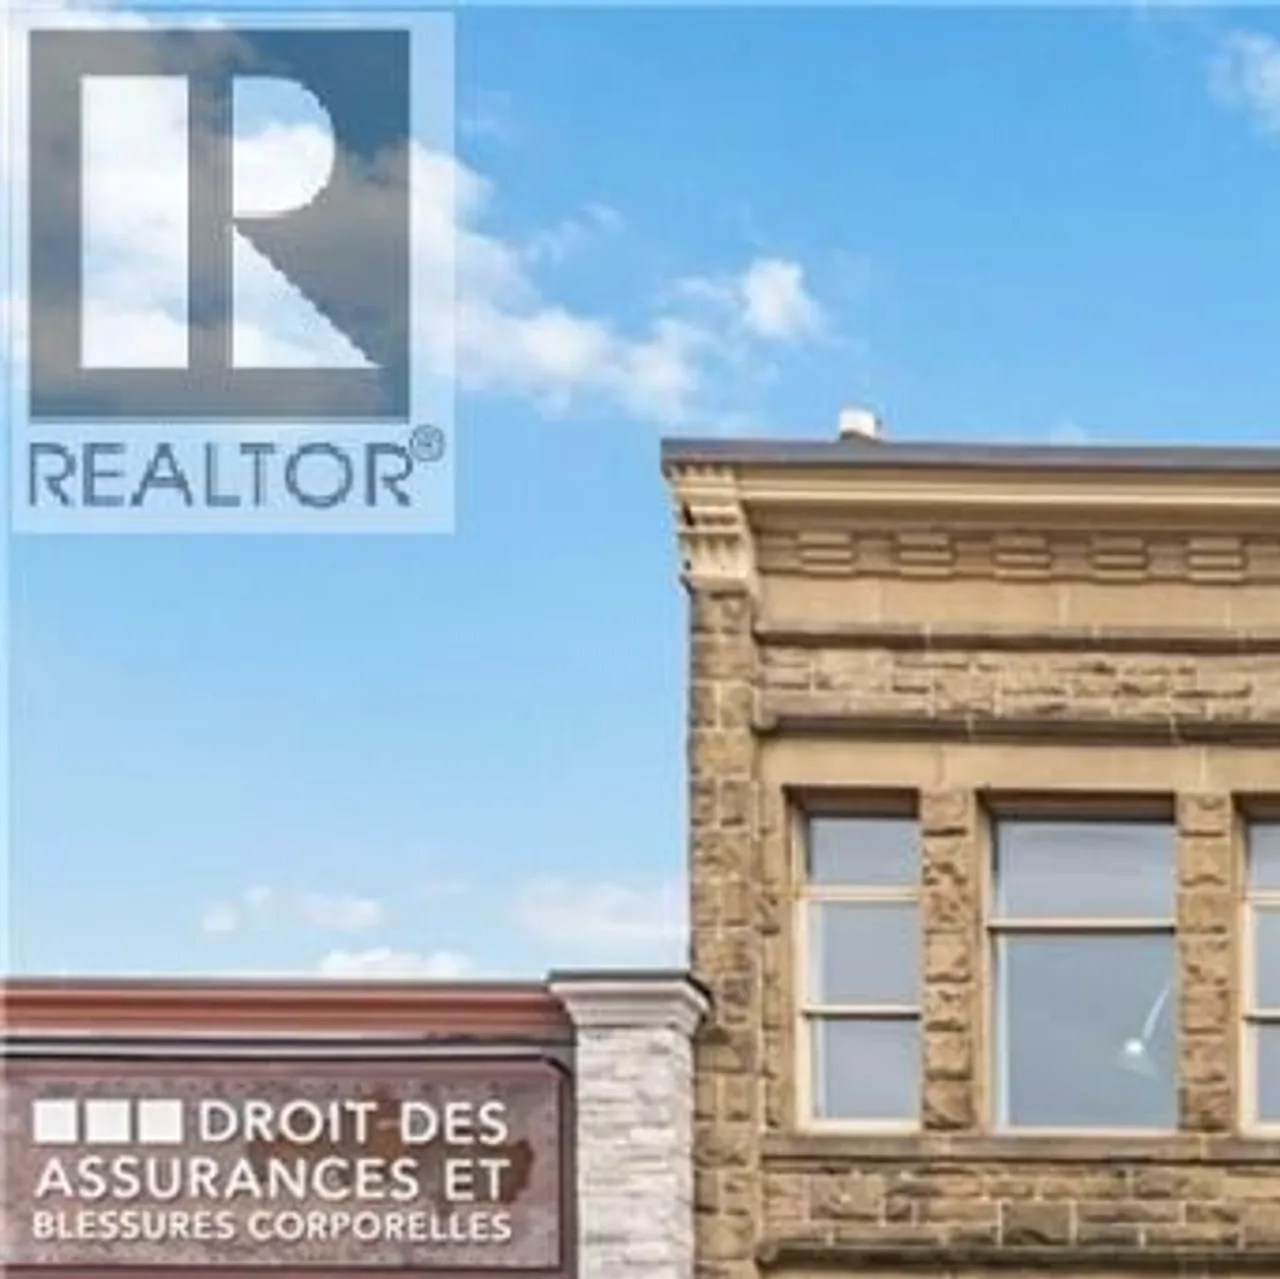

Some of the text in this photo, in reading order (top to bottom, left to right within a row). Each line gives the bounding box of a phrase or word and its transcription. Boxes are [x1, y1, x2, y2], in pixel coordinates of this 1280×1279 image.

[200, 1100, 510, 1145] DROIT DES
[34, 1156, 512, 1201] ASSURANCES ET
[32, 1210, 512, 1242] BLESSURES CORPORELLES
